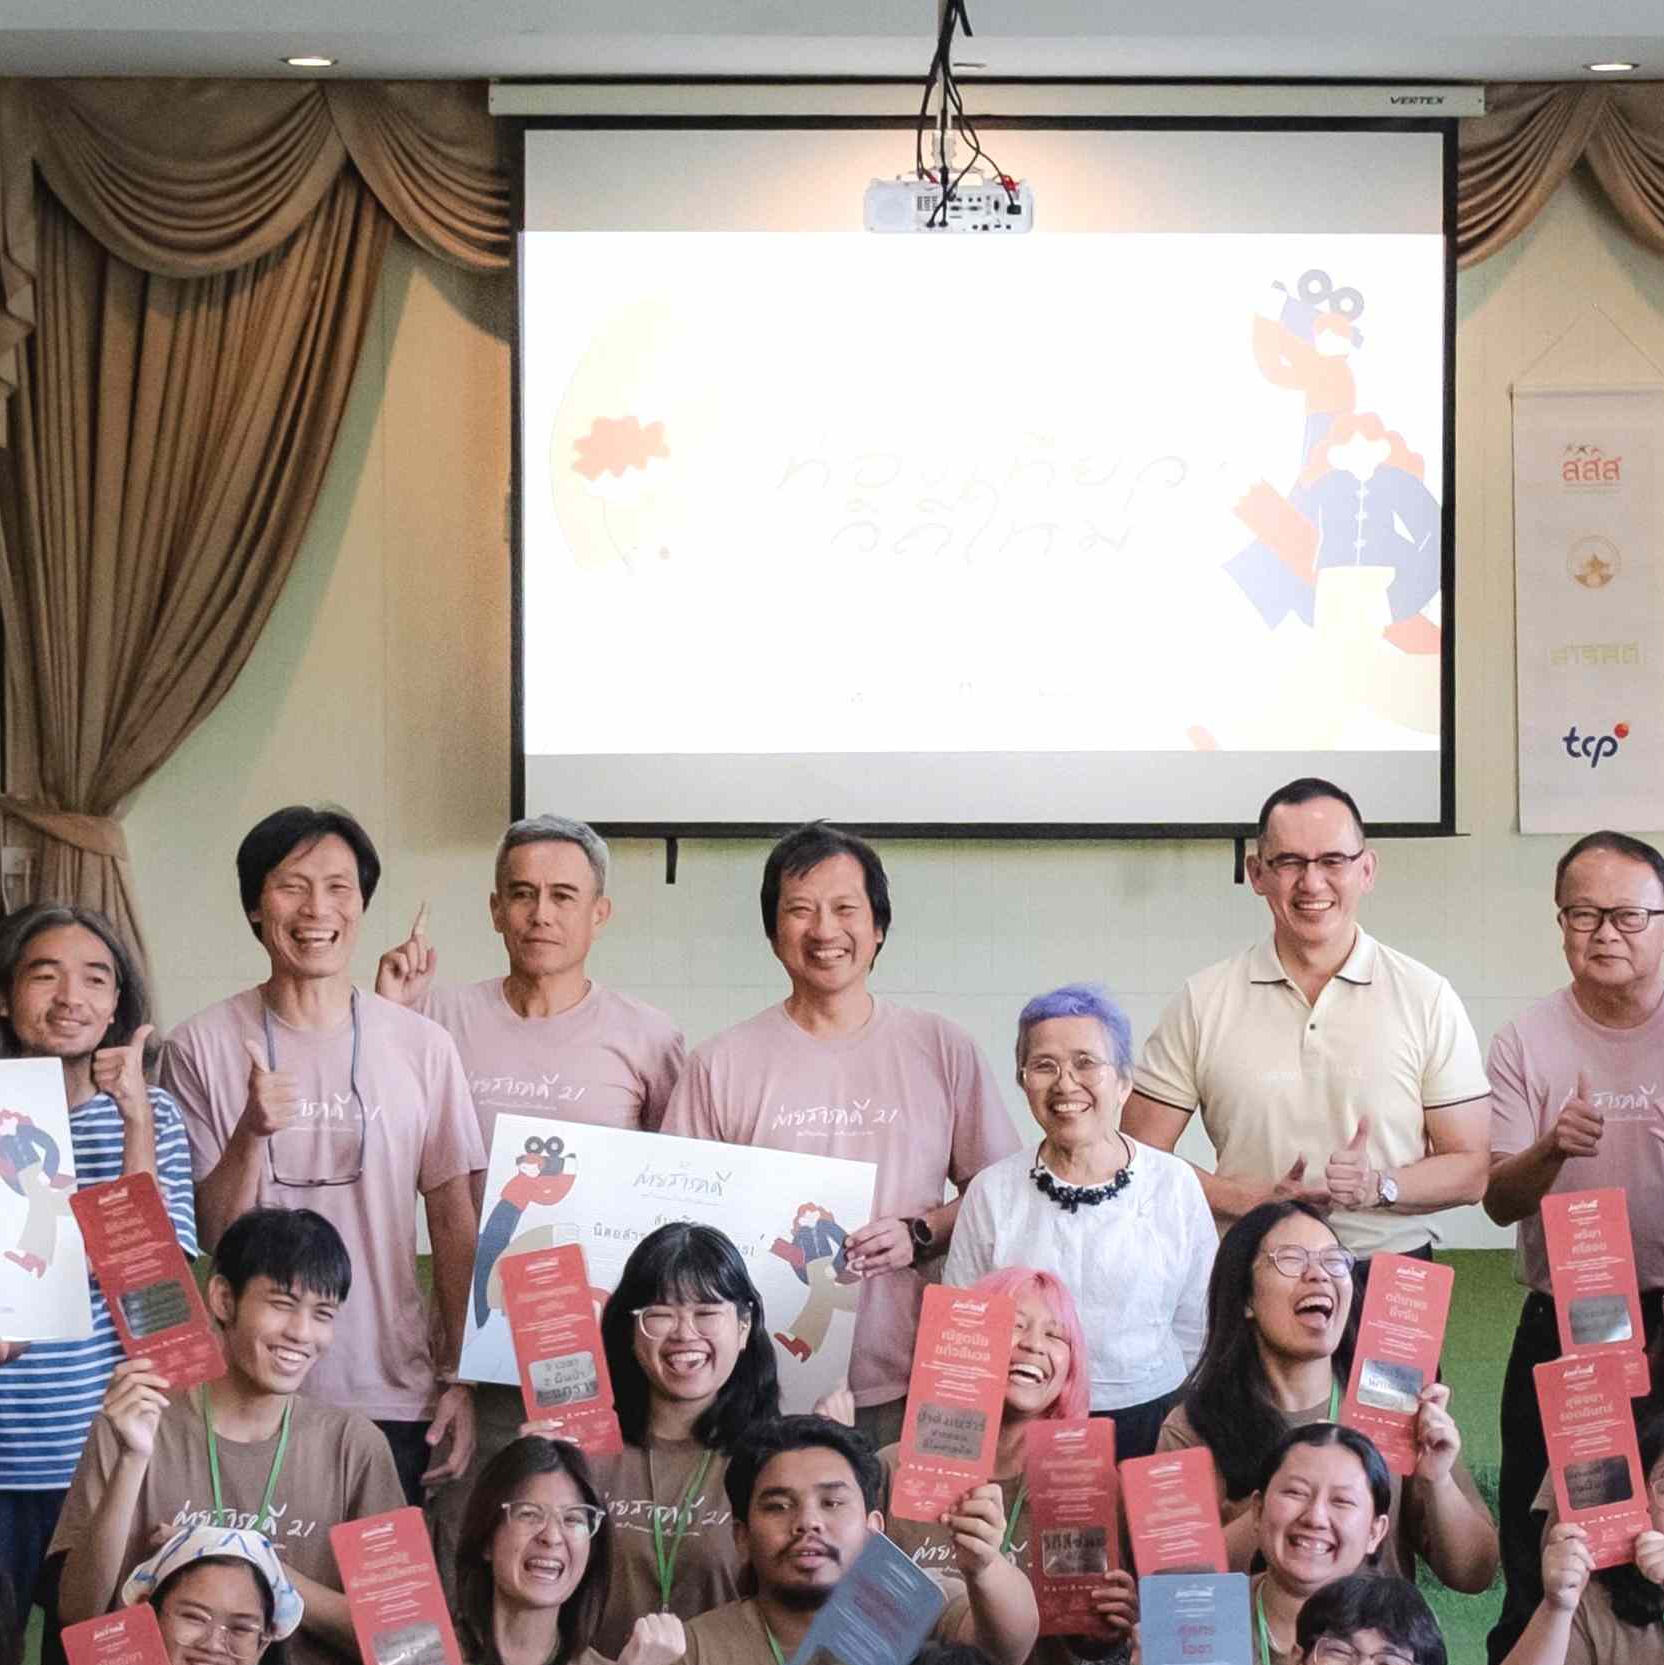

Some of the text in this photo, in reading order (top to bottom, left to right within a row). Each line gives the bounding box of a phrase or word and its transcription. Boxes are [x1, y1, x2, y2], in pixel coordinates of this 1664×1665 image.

[1390, 96, 1446, 105] VERTEX
[1562, 724, 1619, 768] tcp
[872, 1108, 899, 1125] 21
[706, 1510, 734, 1527] 21
[288, 1518, 316, 1538] 21
